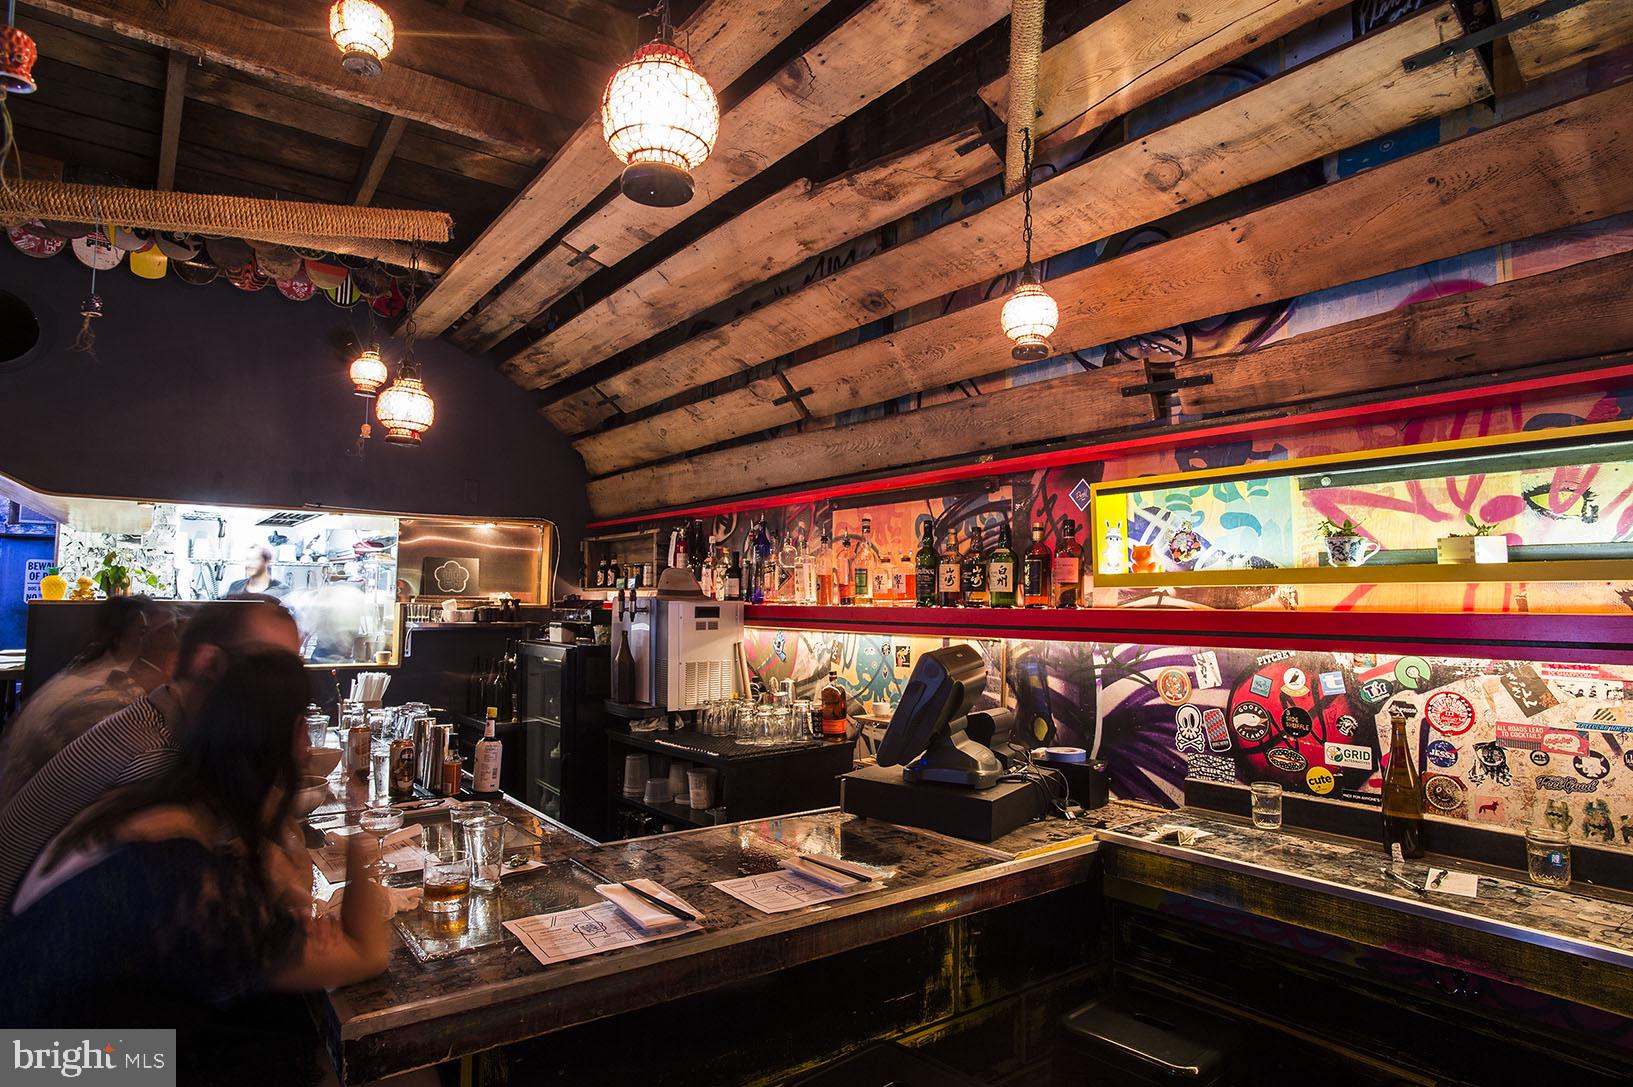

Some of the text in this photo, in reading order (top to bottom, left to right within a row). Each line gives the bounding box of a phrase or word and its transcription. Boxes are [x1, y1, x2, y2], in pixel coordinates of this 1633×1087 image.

[29, 571, 41, 581] OF
[1256, 650, 1297, 666] PITCREW
[1238, 704, 1263, 715] GOOSE
[1238, 728, 1265, 739] ISLAND
[1510, 731, 1542, 739] COCKTAILS
[1343, 748, 1371, 761] GRID
[1308, 774, 1332, 786] cute
